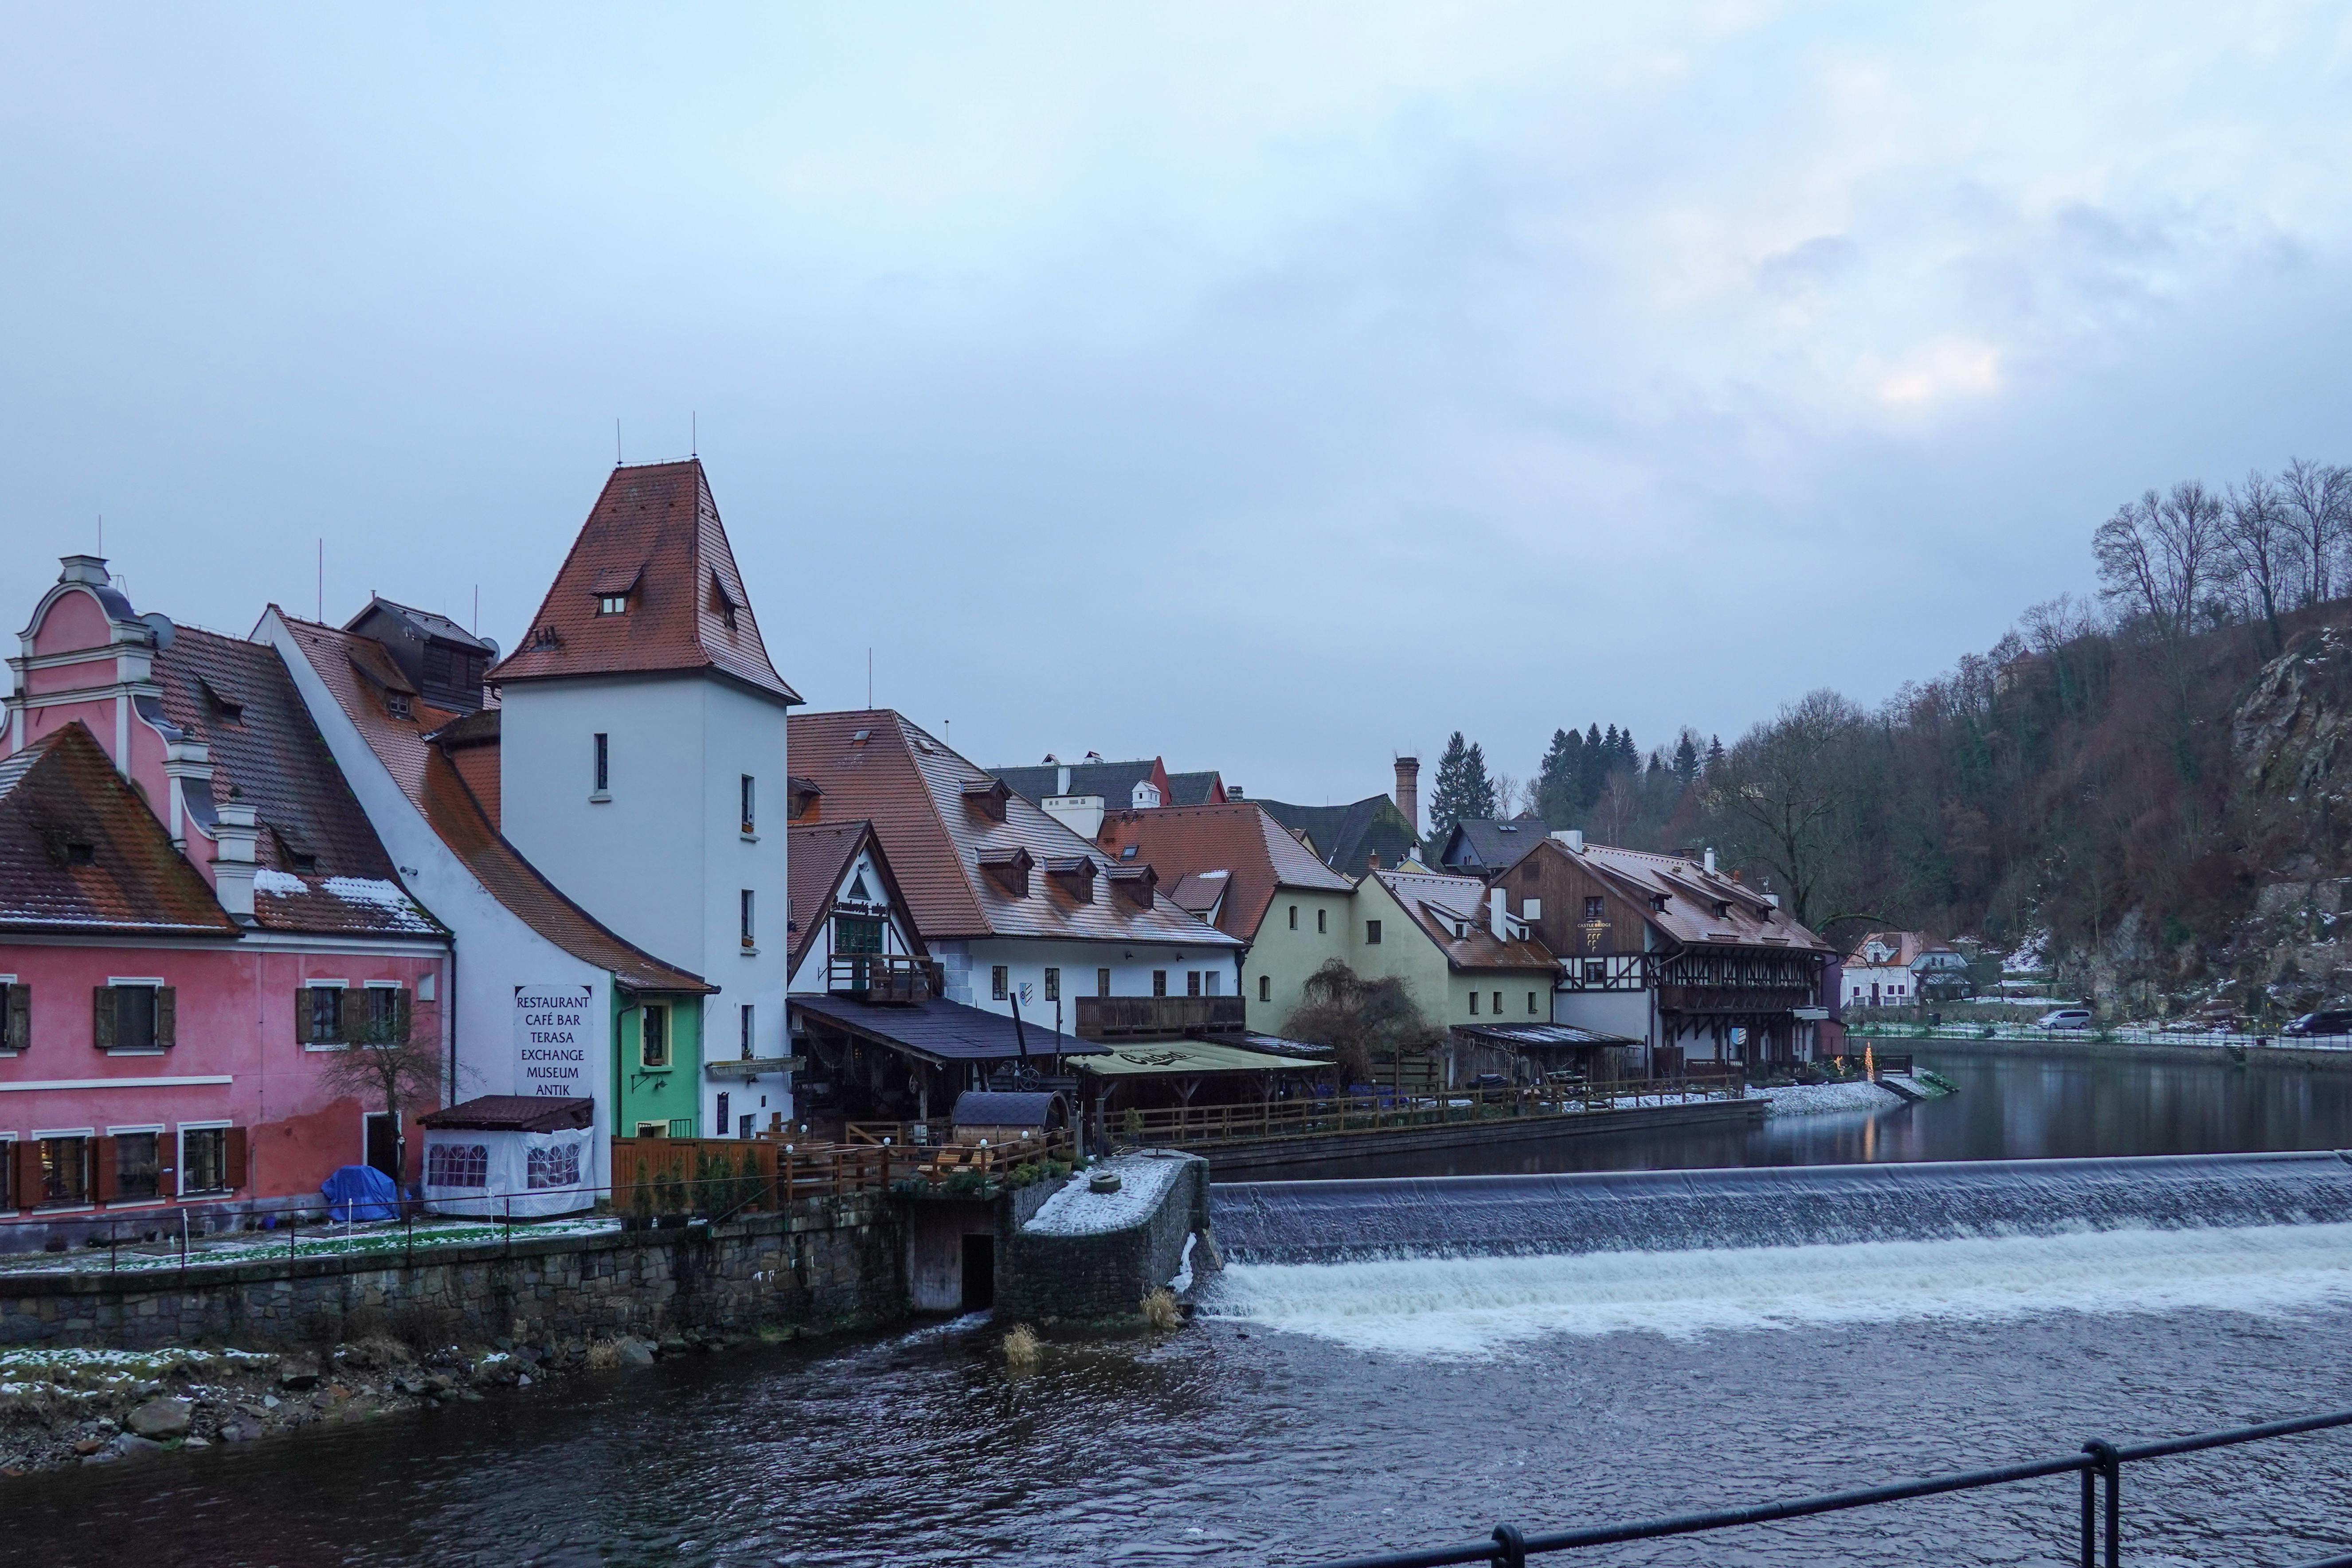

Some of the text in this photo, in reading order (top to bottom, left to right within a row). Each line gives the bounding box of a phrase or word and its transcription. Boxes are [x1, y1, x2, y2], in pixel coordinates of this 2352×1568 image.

[517, 997, 589, 1008] RESTAURANT
[526, 1012, 581, 1025] CAFÉ BAR
[530, 1032, 574, 1043] TERASA
[521, 1049, 584, 1060] EXCHANGE
[527, 1067, 579, 1078] MUSEUM
[536, 1085, 571, 1095] ANTIK
